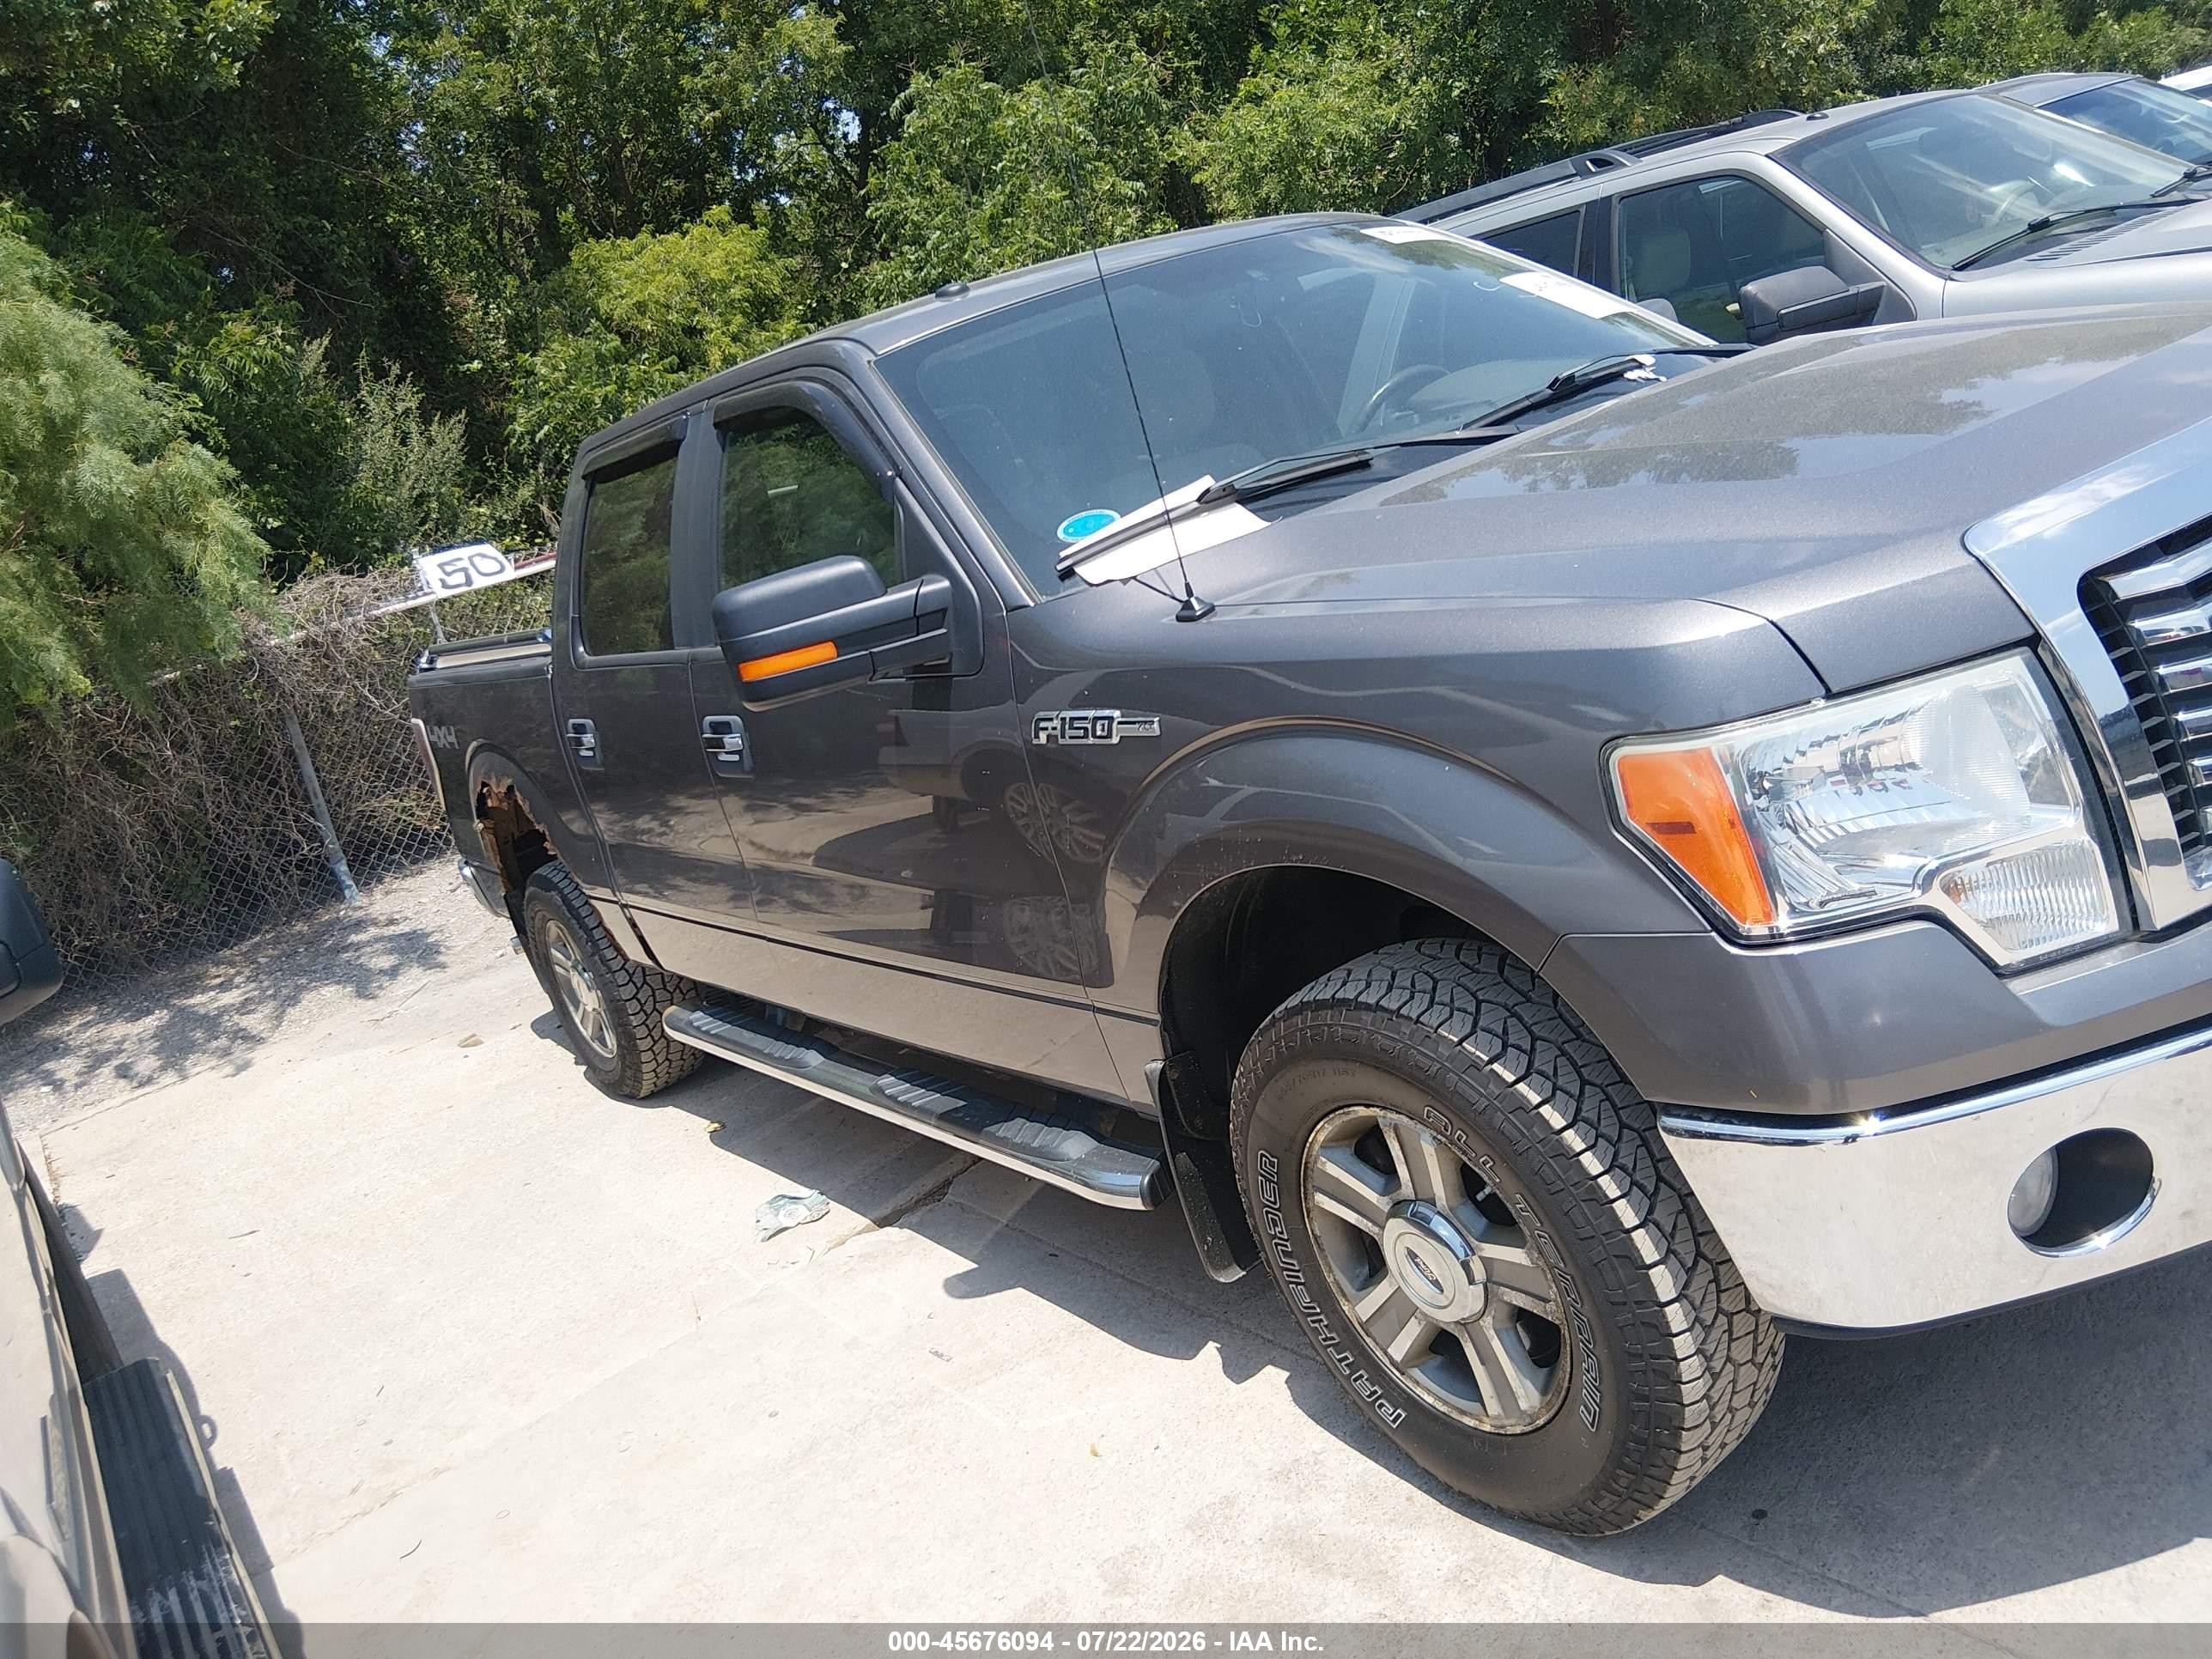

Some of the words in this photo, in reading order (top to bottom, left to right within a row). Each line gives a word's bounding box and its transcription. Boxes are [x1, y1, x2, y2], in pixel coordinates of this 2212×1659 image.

[438, 553, 505, 590] 50
[1031, 709, 1121, 744] F-150
[1256, 1150, 1408, 1430] PATHFINDER
[1424, 1105, 1502, 1183] ALL
[1515, 1192, 1601, 1432] TERRAIN
